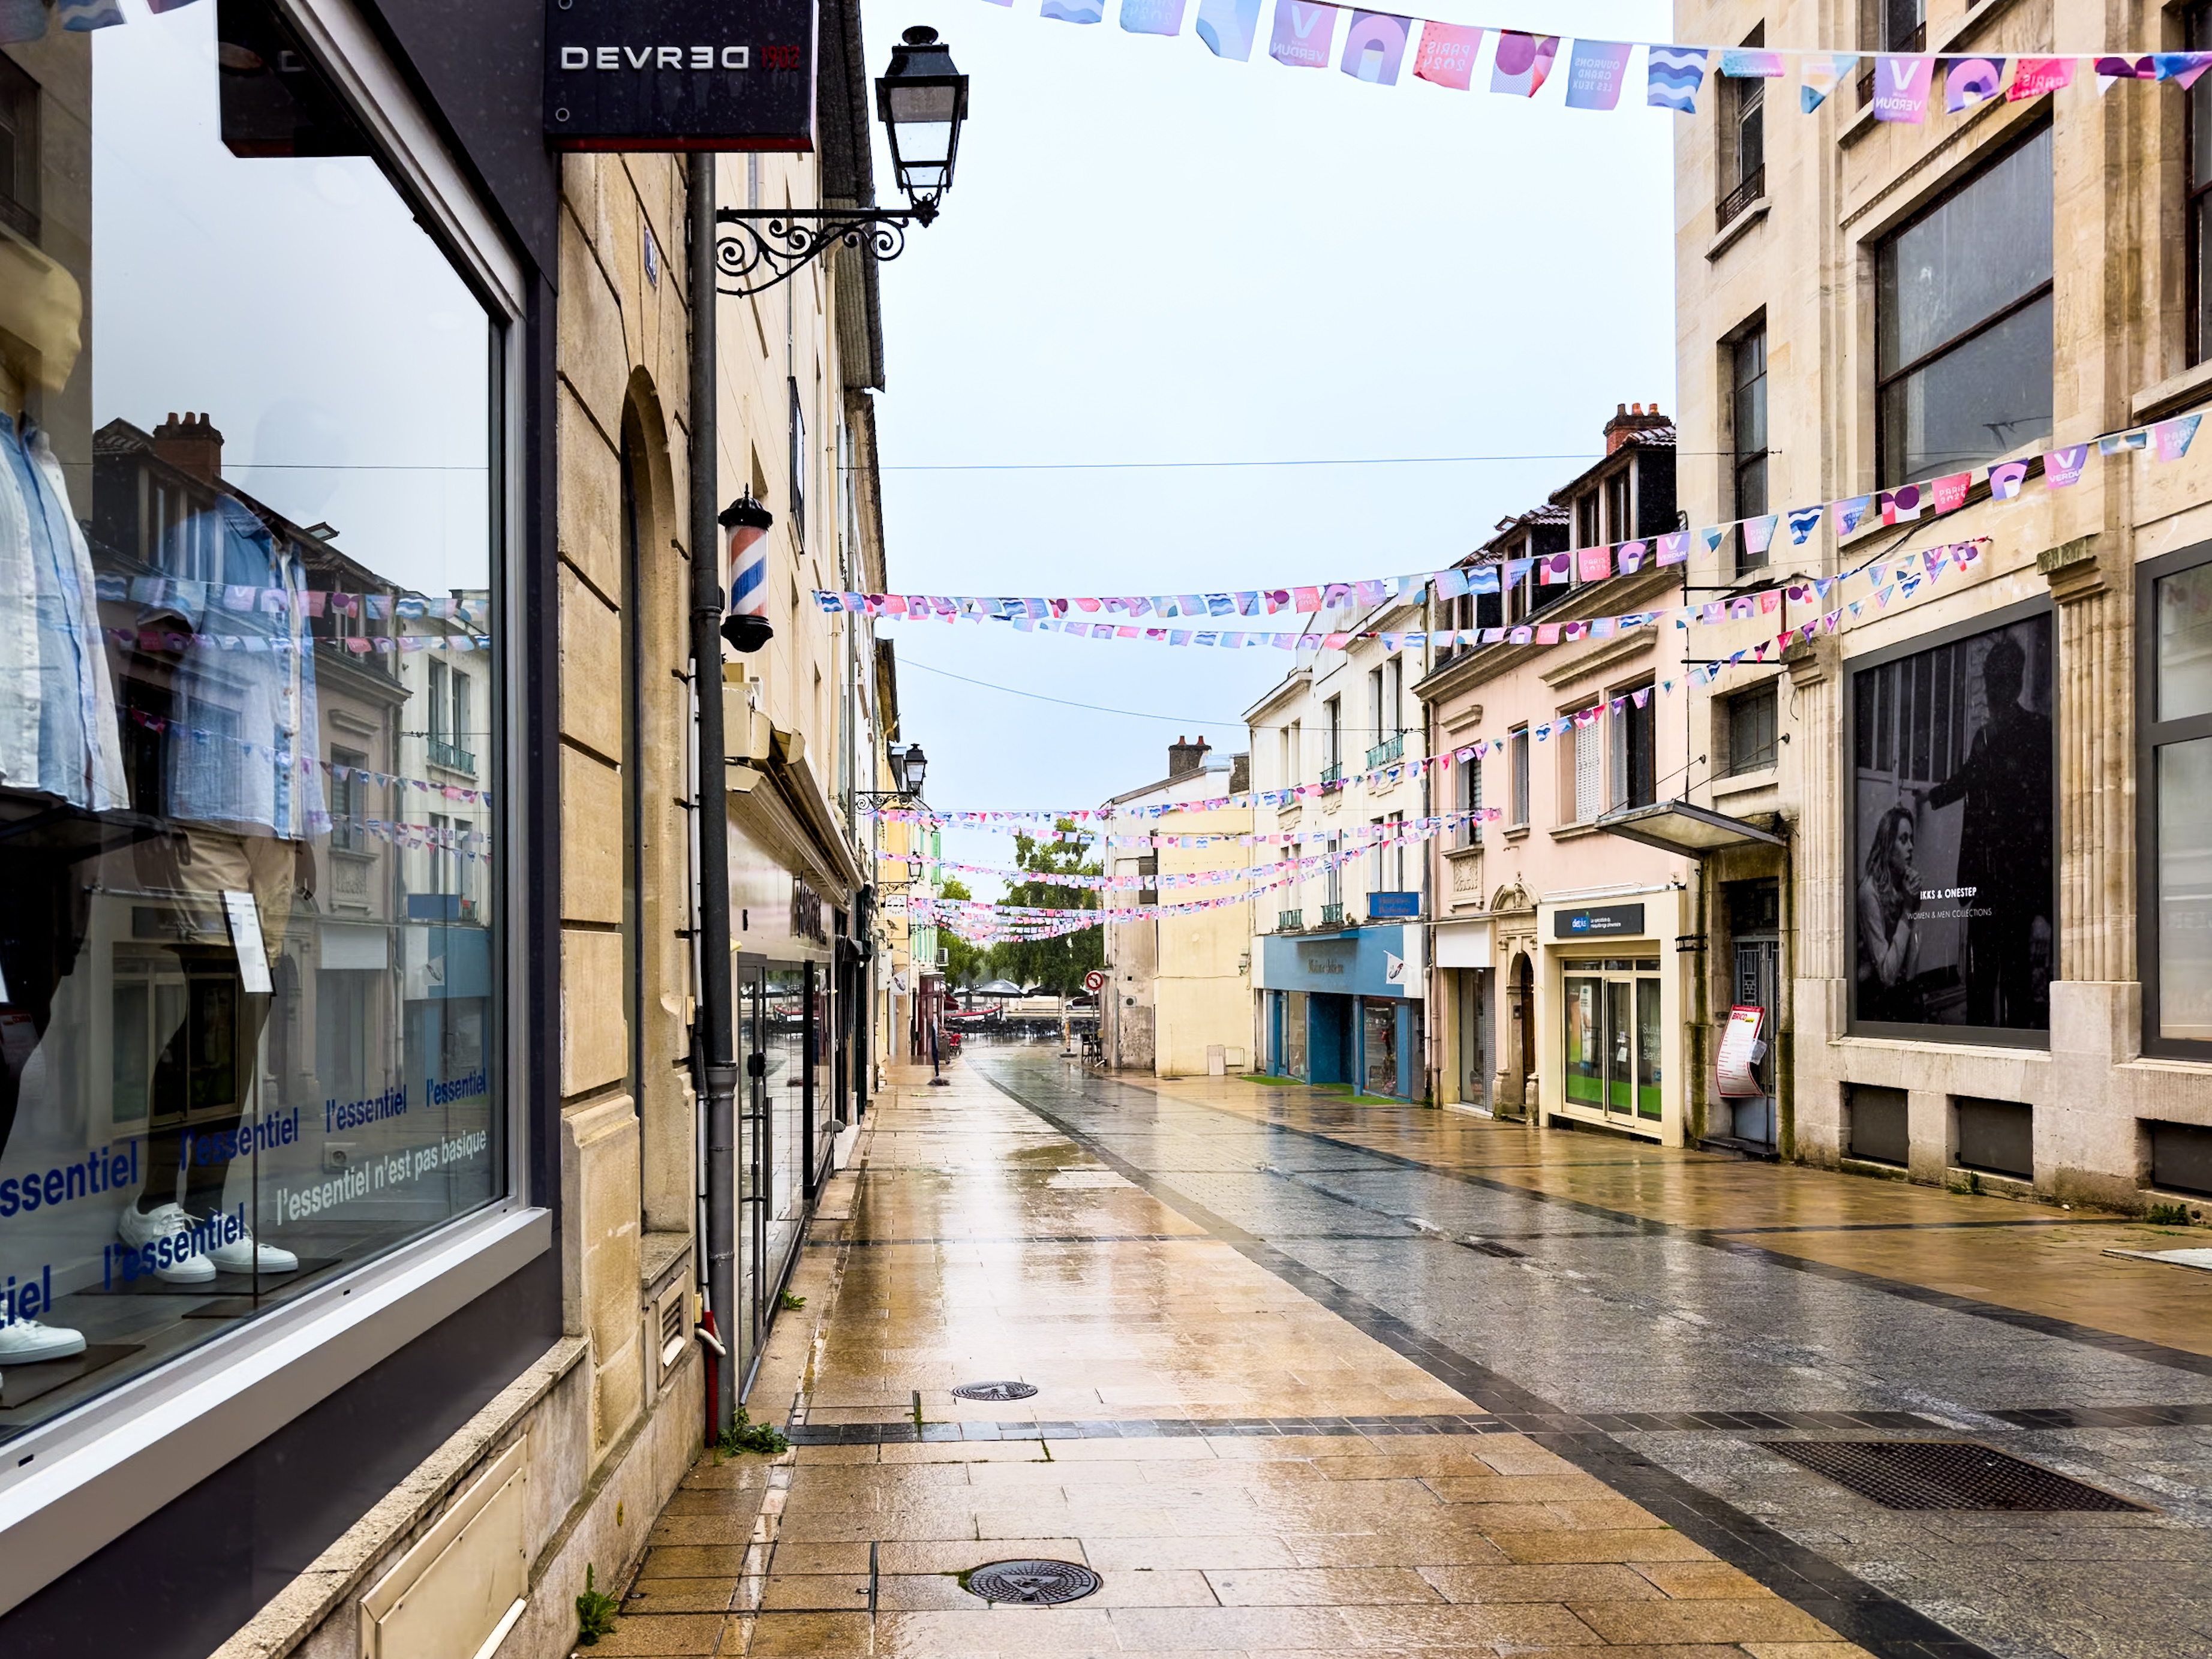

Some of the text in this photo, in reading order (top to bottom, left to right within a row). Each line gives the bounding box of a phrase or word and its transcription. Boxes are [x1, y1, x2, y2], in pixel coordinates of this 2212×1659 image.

[760, 45, 800, 71] 1902
[2053, 449, 2077, 468] V
[2049, 469, 2081, 483] VERDU
[1939, 484, 1966, 497] PARIS
[1664, 534, 1682, 550] V
[1583, 558, 1606, 566] PARIS
[1658, 549, 1687, 562] VERDUN
[1584, 564, 1606, 573] 2024
[1920, 886, 1977, 900] IKKS & ONESTEP
[1907, 911, 1930, 919] WOMEN
[1937, 910, 1950, 918] MEN
[1951, 907, 1992, 918] COLLECTIONS
[426, 1068, 486, 1108] l'essentiel
[326, 1084, 407, 1133] l'essentiel
[181, 1107, 298, 1171] l'essentiel
[276, 1130, 487, 1225] l'essentiel n'est pas basique
[104, 1202, 245, 1291] l'essentiel
